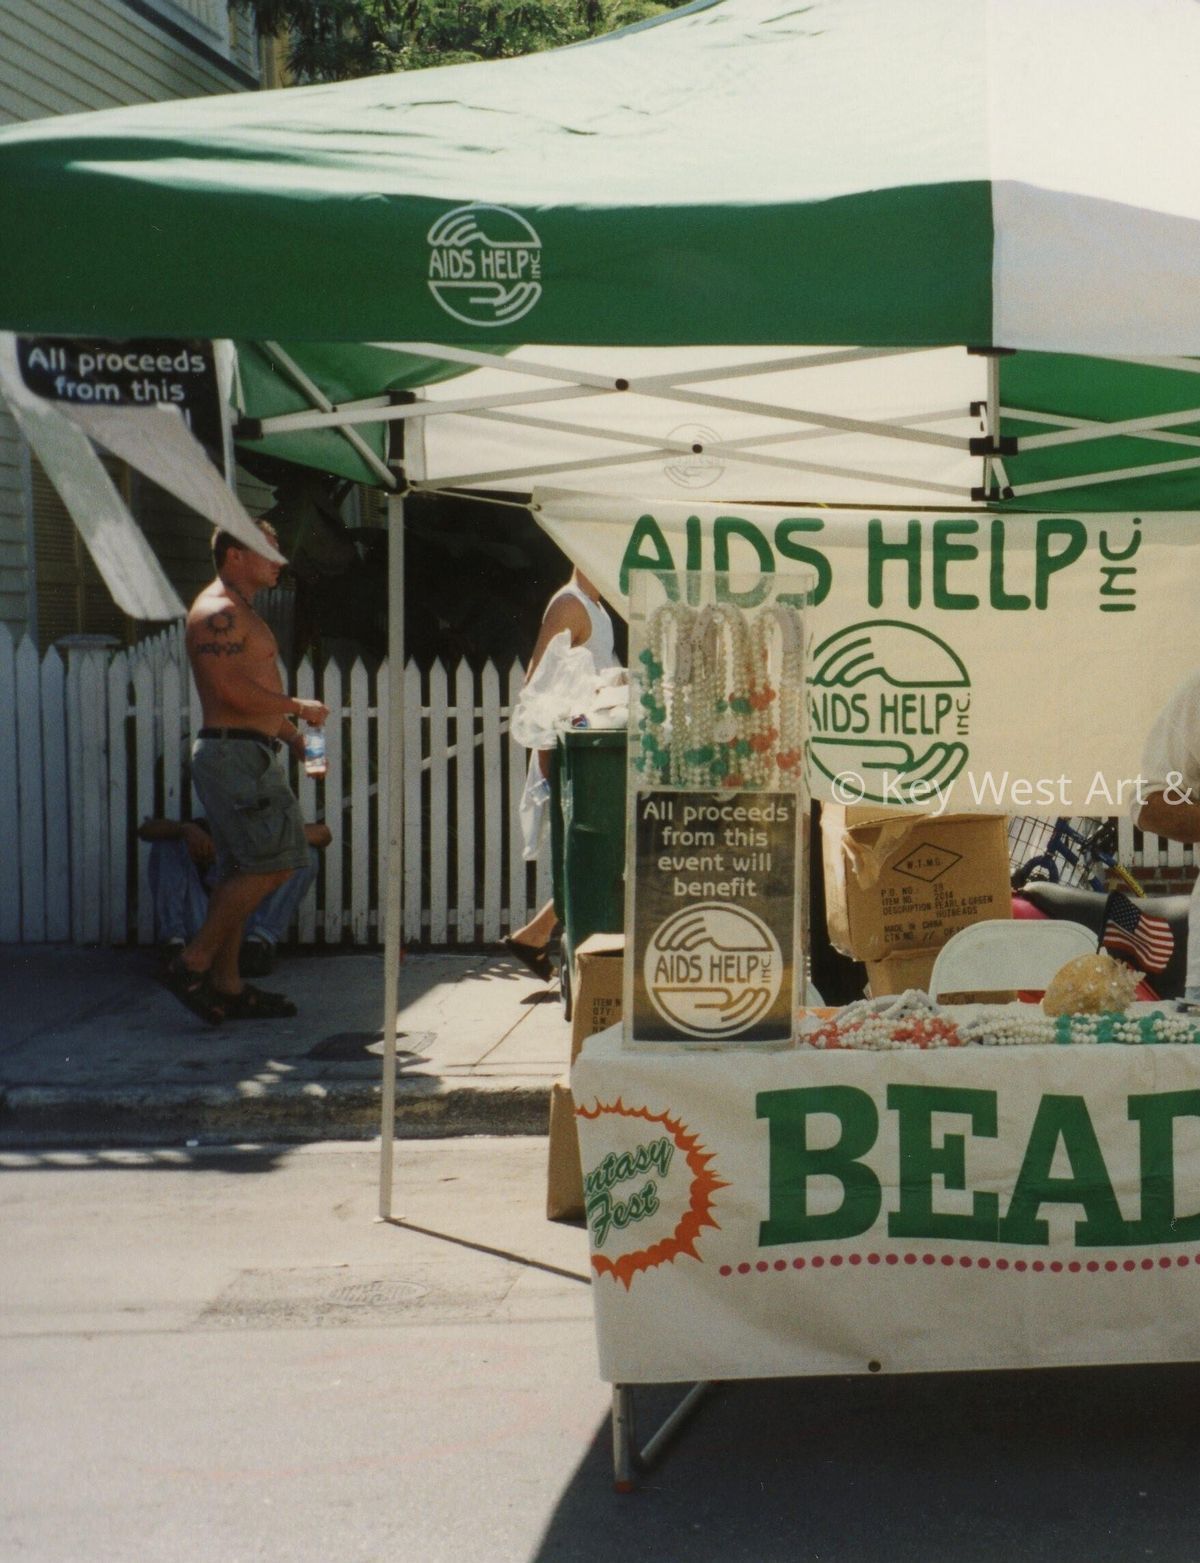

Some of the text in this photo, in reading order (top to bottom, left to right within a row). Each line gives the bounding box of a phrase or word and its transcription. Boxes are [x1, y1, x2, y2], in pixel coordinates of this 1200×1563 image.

[428, 248, 477, 279] AIDS
[480, 248, 529, 279] HELP
[28, 348, 206, 377] All proceeds
[55, 375, 186, 401] from this
[619, 514, 1143, 613] AIDS HELP INC.
[879, 692, 953, 735] HELP
[955, 692, 972, 736] INC.
[642, 801, 790, 826] All proceeds
[661, 827, 769, 848] from this
[657, 852, 772, 873] event will
[673, 877, 758, 897] benefit
[654, 955, 704, 984] AIDS
[708, 955, 760, 984] HELP
[585, 1136, 675, 1192] ntasy
[587, 1180, 660, 1248] Fest
